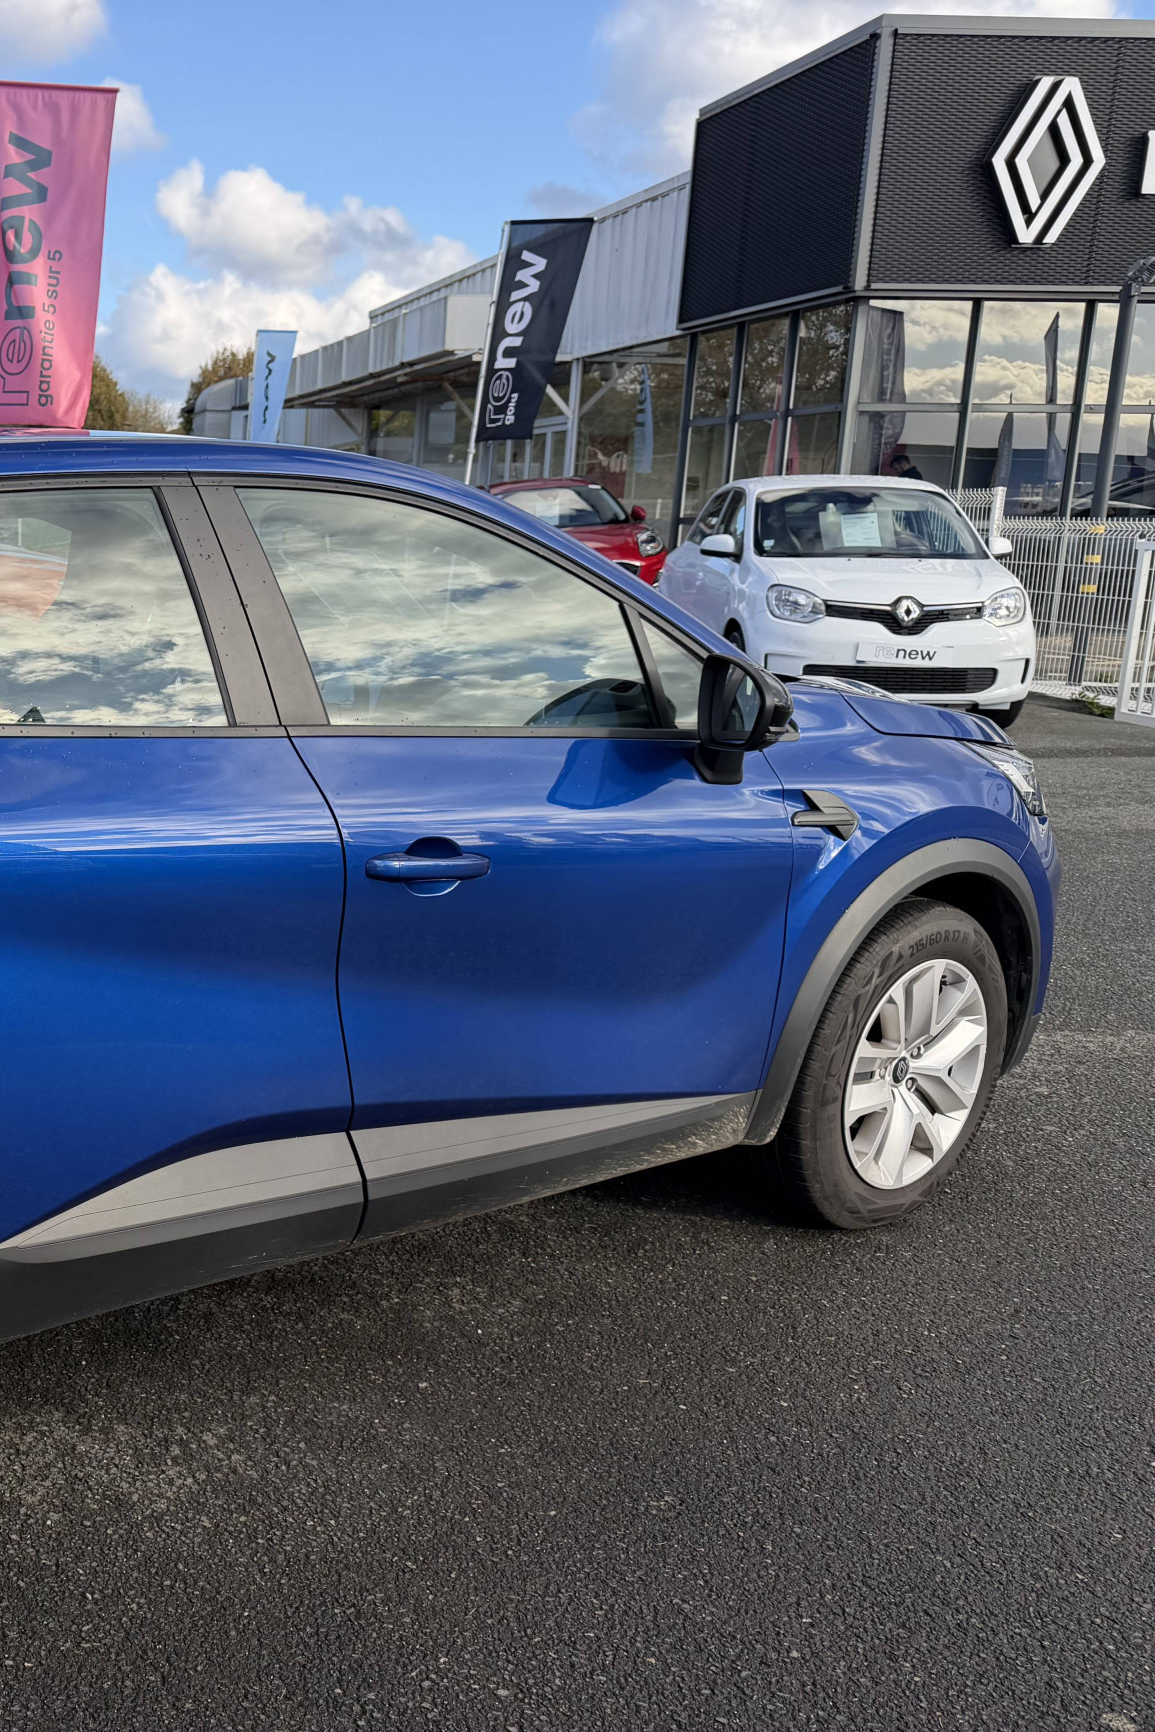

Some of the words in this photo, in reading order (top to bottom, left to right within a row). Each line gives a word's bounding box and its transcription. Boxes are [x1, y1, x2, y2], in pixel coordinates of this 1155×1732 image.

[47, 249, 63, 262] 5
[46, 266, 61, 300] sur
[42, 303, 56, 315] 5
[486, 250, 548, 427] renew
[38, 319, 55, 407] garantie
[505, 392, 519, 425] gold
[874, 646, 937, 661] renew
[908, 931, 942, 958] 215/60
[943, 929, 950, 943] R
[951, 929, 961, 943] 17
